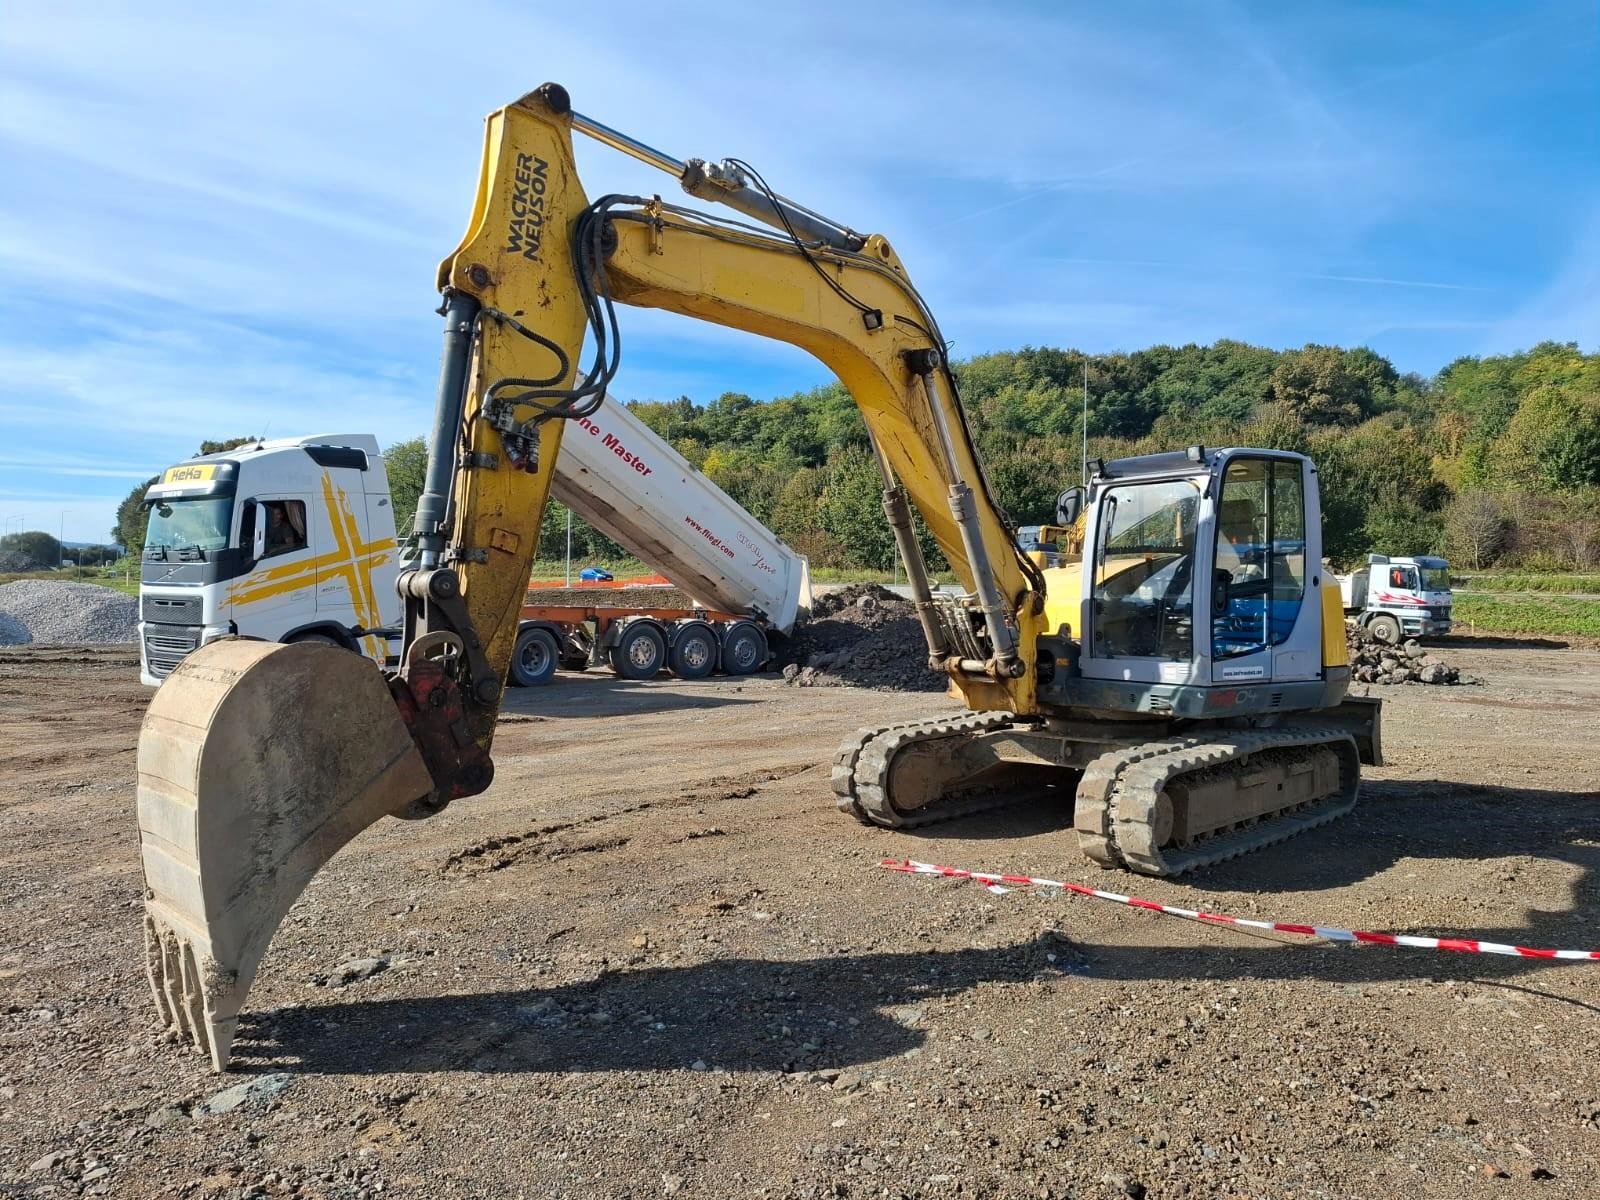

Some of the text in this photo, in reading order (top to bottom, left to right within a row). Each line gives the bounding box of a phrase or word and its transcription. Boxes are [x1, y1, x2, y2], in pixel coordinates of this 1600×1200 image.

[507, 152, 532, 253] WACKER
[523, 157, 549, 262] NEUSON
[171, 467, 203, 482] KeKa
[601, 433, 653, 477] Master
[685, 515, 736, 559] www.fliegl.com
